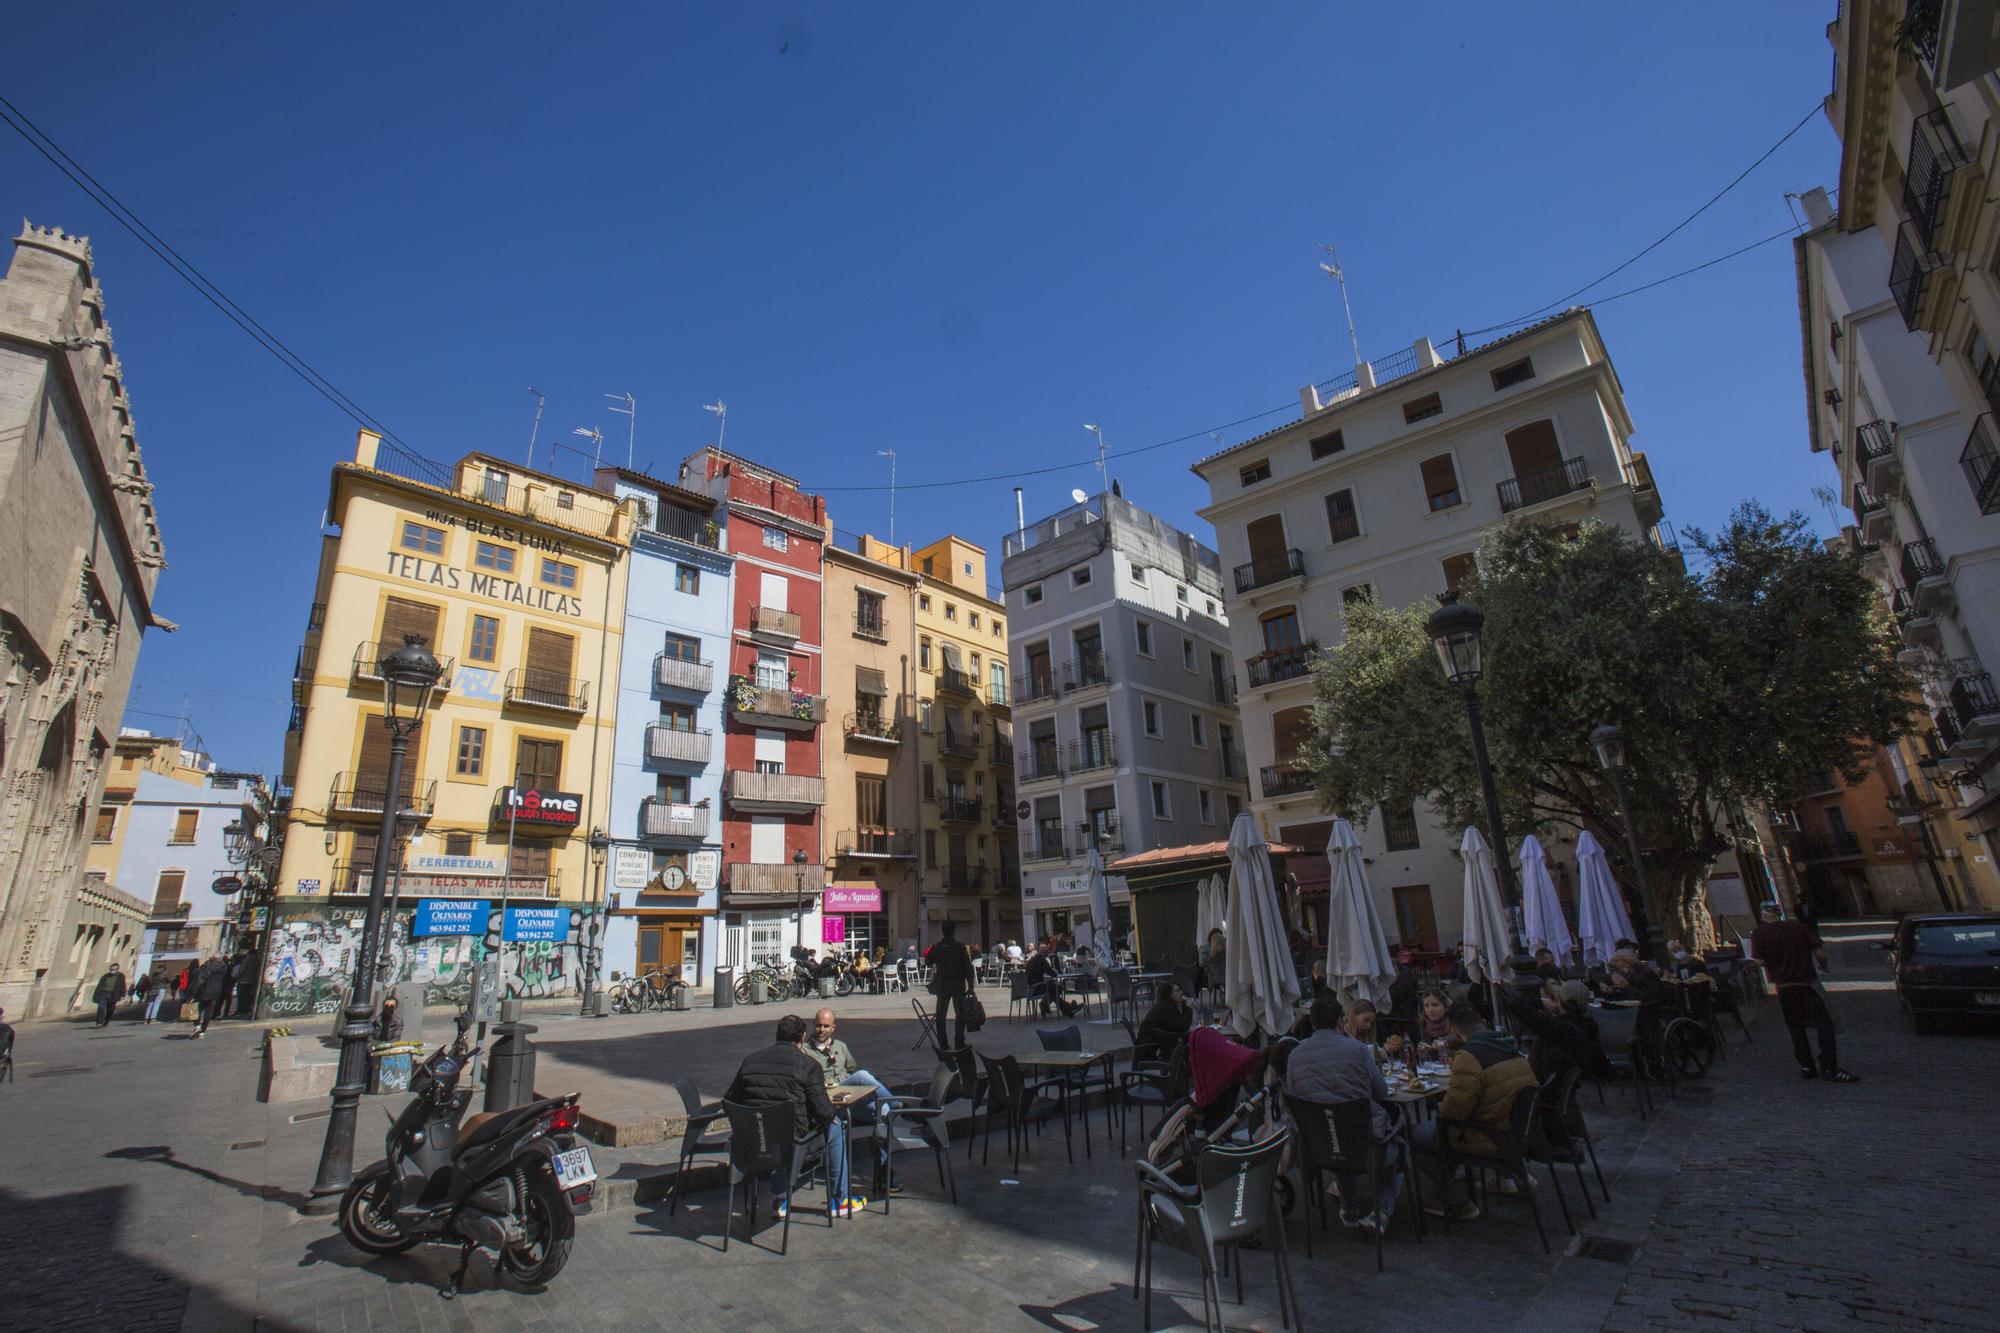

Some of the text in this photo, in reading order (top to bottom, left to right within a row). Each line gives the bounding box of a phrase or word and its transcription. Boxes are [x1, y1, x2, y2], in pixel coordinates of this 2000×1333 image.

[426, 510, 564, 556] HIJA BLAS LUNA
[387, 551, 582, 617] TELAS METALICAS
[505, 808, 576, 822] youth hostel
[618, 851, 647, 860] COMPRA
[418, 857, 494, 869] FERRETERIA
[430, 874, 468, 888] TELAS
[474, 877, 545, 890] METALICAS
[829, 891, 848, 904] Julio
[851, 891, 878, 904] Ignacio
[429, 901, 478, 911] DISPONIBLE
[431, 911, 472, 920] OLIVARES
[514, 909, 560, 918] DISPONIBLE
[429, 925, 443, 933] 963
[457, 924, 471, 932] 282
[517, 918, 555, 927] OLIVARES
[516, 931, 554, 939] 963 942 282
[562, 1149, 587, 1168] 3697
[565, 1164, 586, 1181] LKW
[1234, 1172, 1247, 1217] Heineken
